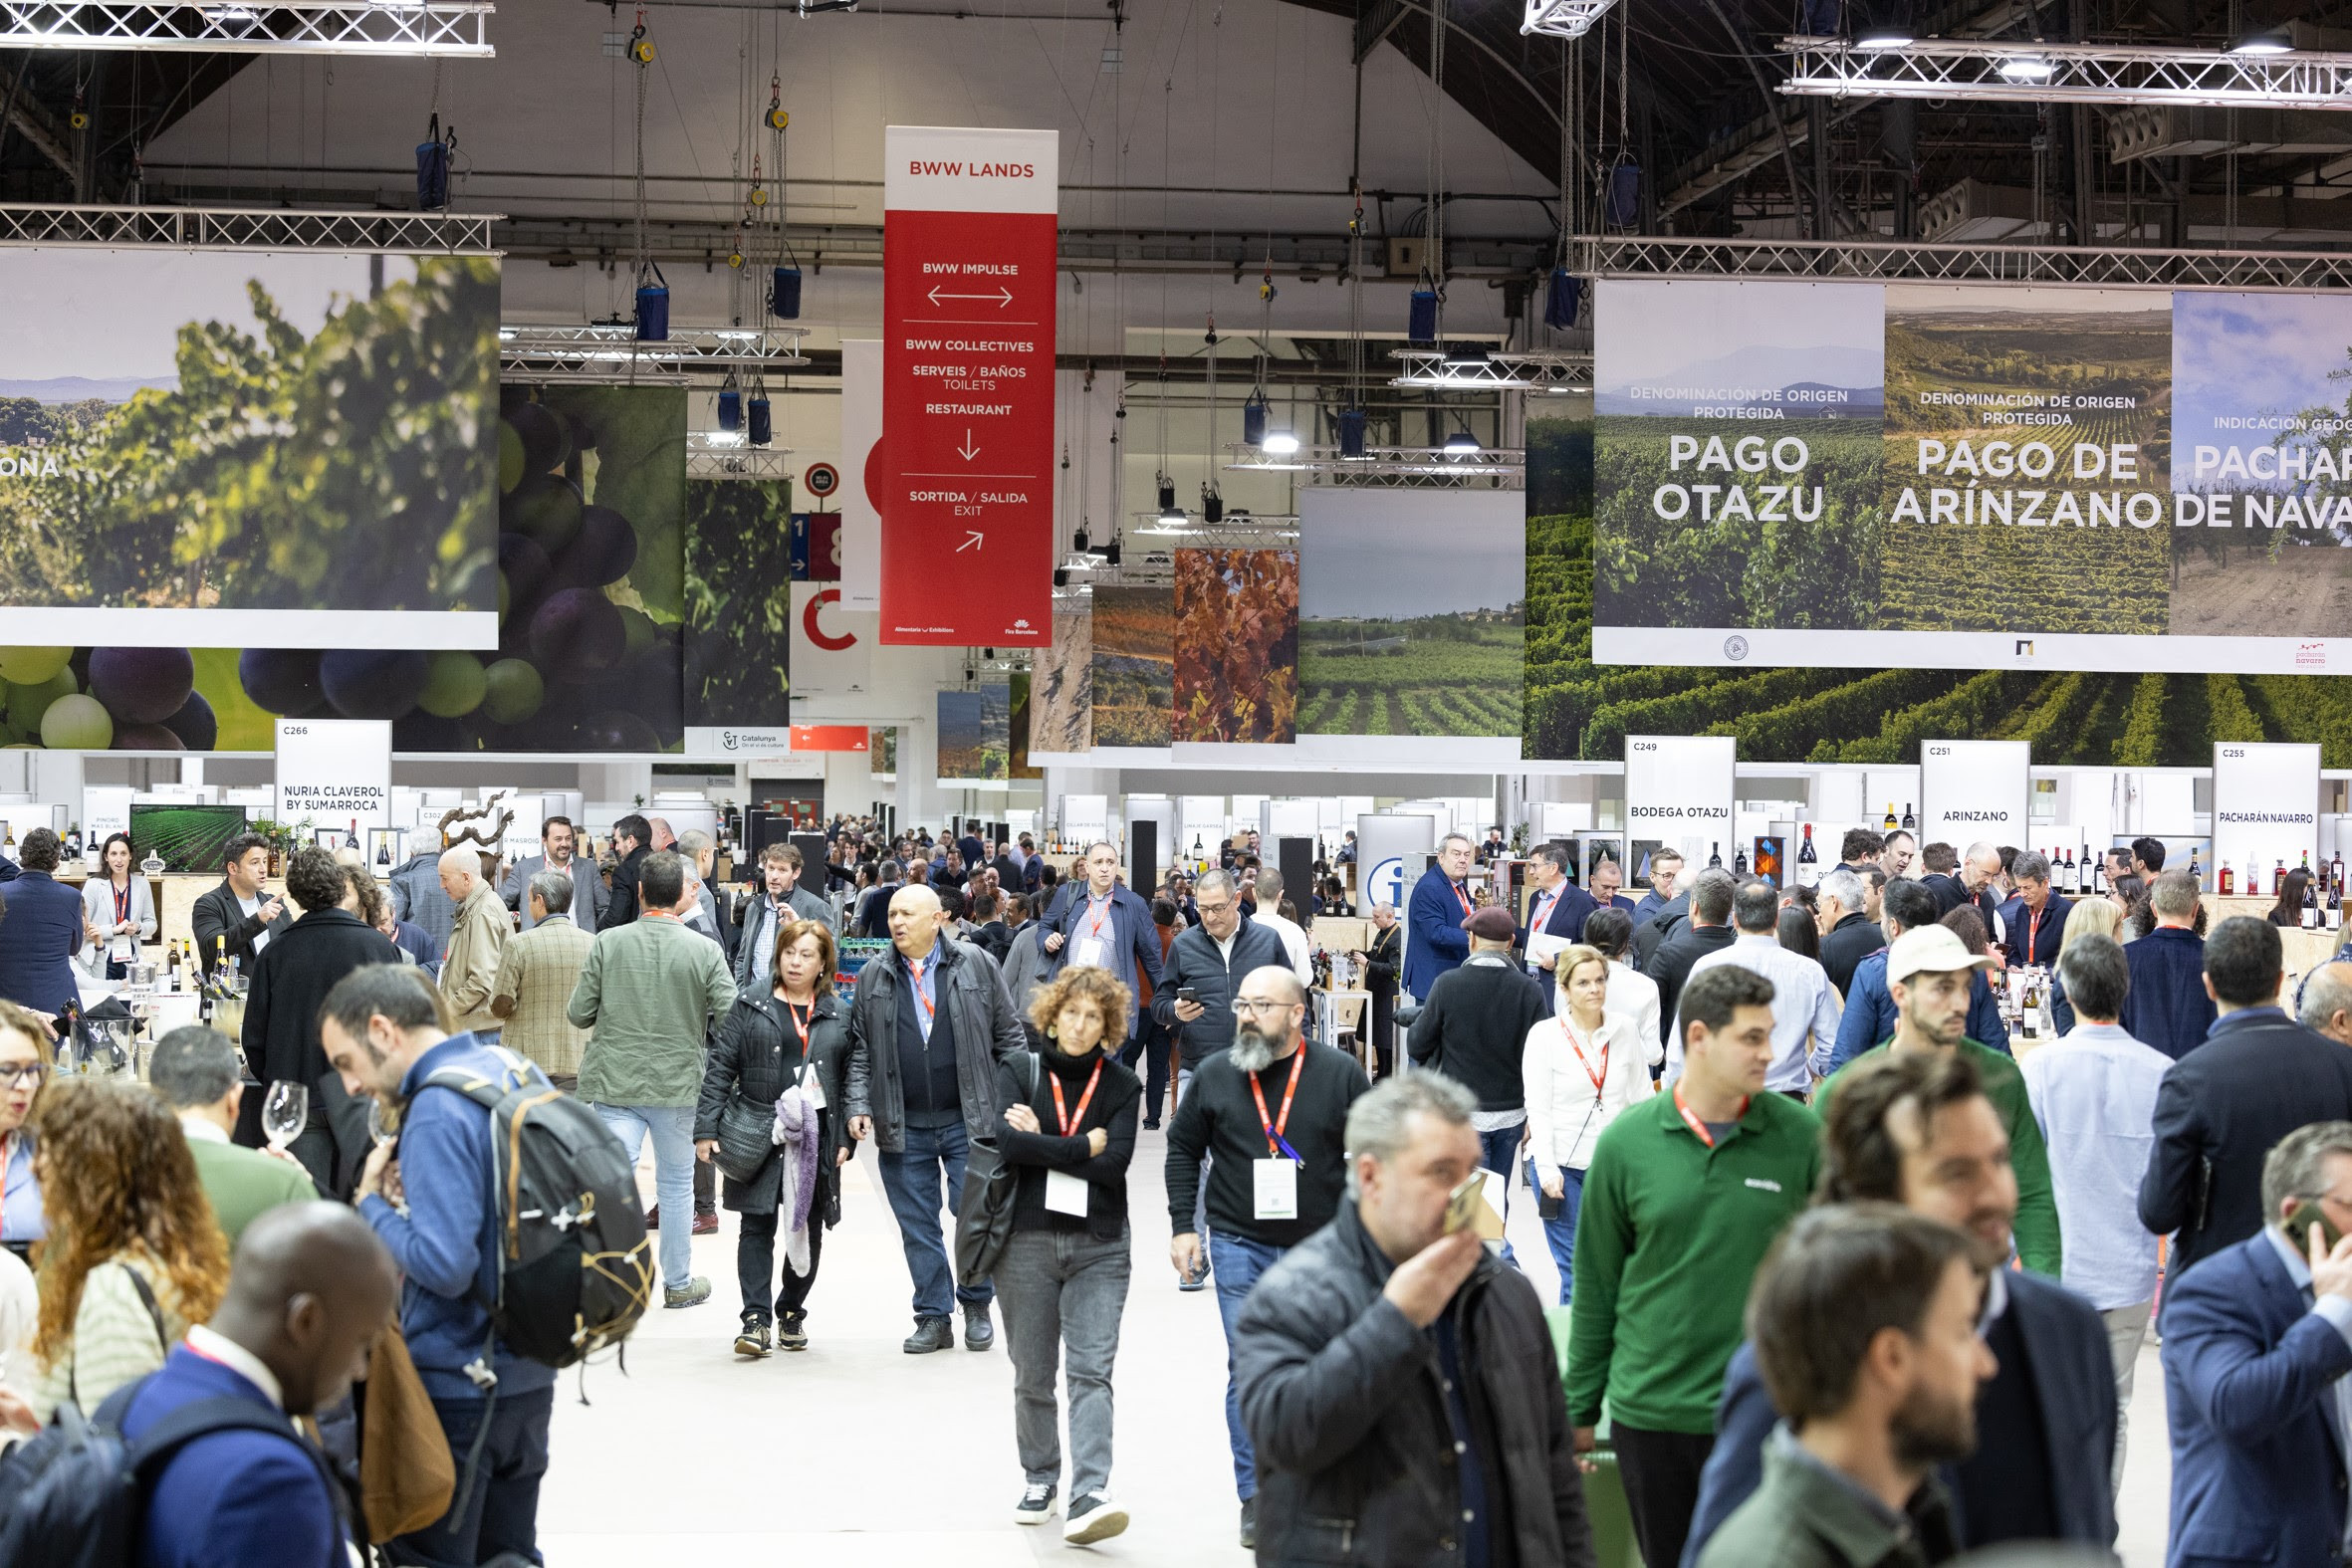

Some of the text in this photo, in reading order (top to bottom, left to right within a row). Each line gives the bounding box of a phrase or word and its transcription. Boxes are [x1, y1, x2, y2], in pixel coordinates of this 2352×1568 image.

[909, 160, 1035, 178] BWW LANDS
[923, 263, 1019, 276] BWW IMPULSE
[905, 339, 1034, 352] BWW COLLECTIVES
[912, 364, 1027, 377] SERVEIS / BAÑOS
[943, 379, 996, 391] TOILETS
[1630, 385, 1848, 402] DENOMINACIÓN DE ORIGEN
[1920, 392, 2136, 409] DENOMINACIÓN DE ORIGEN
[925, 403, 1012, 415] RESTAURANT
[1694, 406, 1784, 420] PROTEGIDA
[1983, 412, 2073, 426] PROTEGIDA
[1670, 434, 1809, 473] PAGO
[1918, 439, 2138, 480] PAGO DE
[909, 491, 1028, 504] SORTIDA / SALIDA
[1653, 483, 1823, 522] OTAZU
[1890, 478, 2162, 530] ARÍNZANO
[954, 506, 983, 516] EXIT
[2175, 494, 2233, 528] DE
[283, 726, 308, 735] C266
[1633, 742, 1657, 752] C249
[1929, 747, 1951, 756] C251
[2223, 749, 2244, 758] C255
[284, 785, 383, 797] NURIA CLAVEROL
[287, 799, 378, 810] BY SUMARROCA
[1631, 806, 1729, 818] BODEGA OTAZU
[1943, 810, 2008, 822] ARINZANO
[2219, 809, 2313, 824] PACHARÁN NAVARRO
